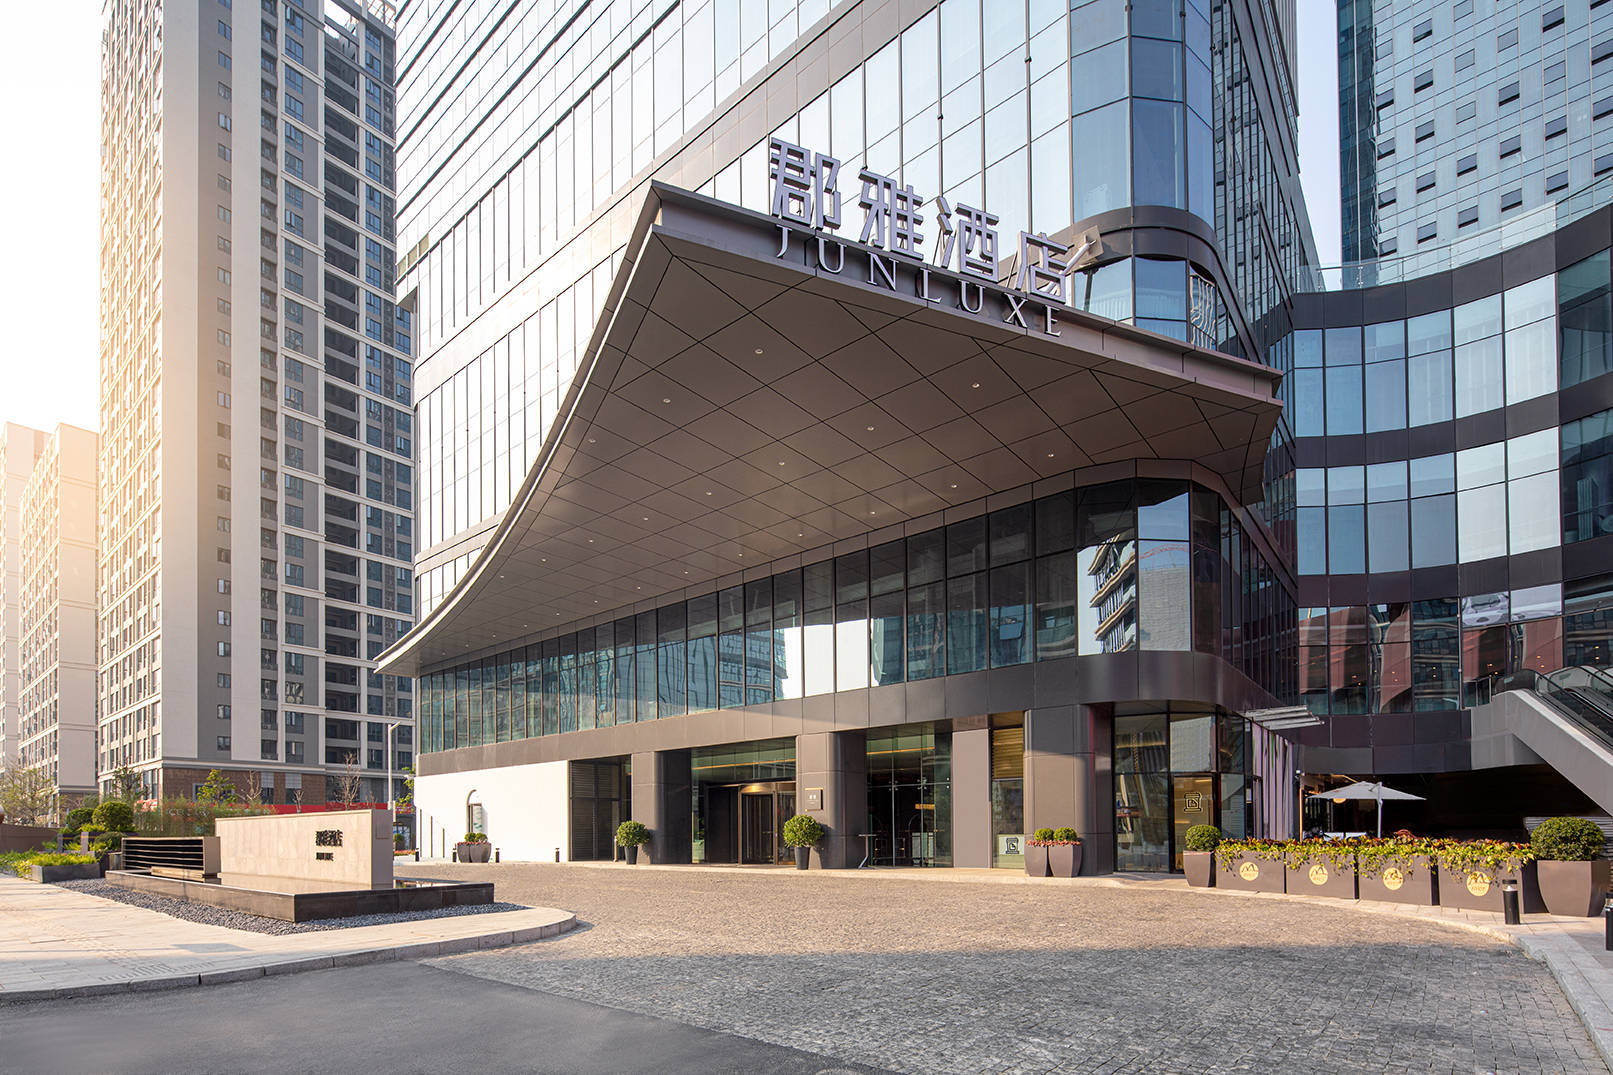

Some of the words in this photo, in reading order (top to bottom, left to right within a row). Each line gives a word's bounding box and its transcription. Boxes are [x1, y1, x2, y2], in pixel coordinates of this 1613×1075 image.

[771, 137, 1067, 304] 郡雅酒店
[776, 224, 1062, 337] JUNLUXE
